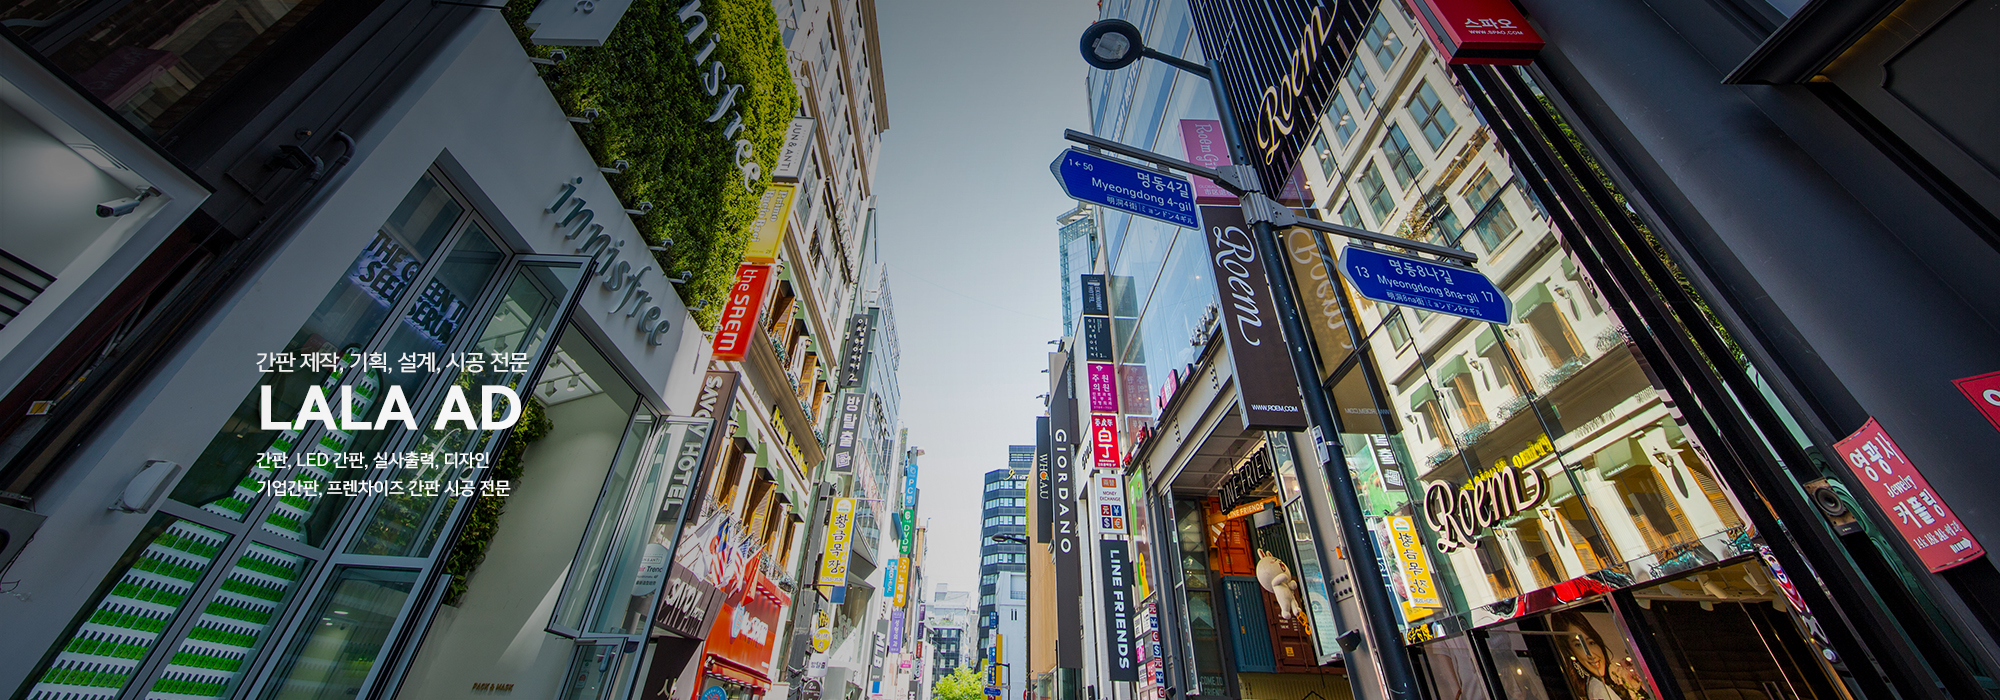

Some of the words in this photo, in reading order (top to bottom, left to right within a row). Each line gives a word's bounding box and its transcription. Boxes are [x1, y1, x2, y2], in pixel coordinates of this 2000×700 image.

[1464, 18, 1518, 30] 스파오
[1194, 123, 1213, 154] Roem
[1068, 158, 1073, 167] 1
[1082, 163, 1095, 172] 50
[1091, 176, 1165, 207] Myeongdong
[1166, 196, 1193, 213] 4-gil
[1136, 170, 1191, 200] 명동4길
[770, 190, 789, 223] Primo
[362, 229, 410, 271] THE
[545, 175, 671, 347] innisfree
[738, 269, 758, 292] the
[1212, 226, 1263, 347] Roem
[1354, 265, 1371, 280] 13
[1376, 273, 1444, 298] Myeongdong
[1444, 287, 1480, 304] 8na-gil
[1388, 259, 1455, 286] 명동8나길
[1480, 290, 1495, 304] 17
[1098, 427, 1114, 459] 白丁
[1849, 431, 1905, 483] 영광사
[662, 441, 701, 511] HOTEL
[1054, 428, 1072, 554] GIORDANO
[1883, 474, 1919, 499] Jewelry
[1219, 475, 1241, 513] LINE
[1240, 503, 1264, 514] FRIENDS
[1424, 466, 1548, 554] Roem
[1892, 487, 1946, 530] 커플링
[1110, 549, 1123, 587] LINE
[1113, 590, 1130, 670] FRIENDS
[873, 632, 886, 668] MLB
[472, 682, 490, 690] PACK
[496, 683, 514, 691] MASK
